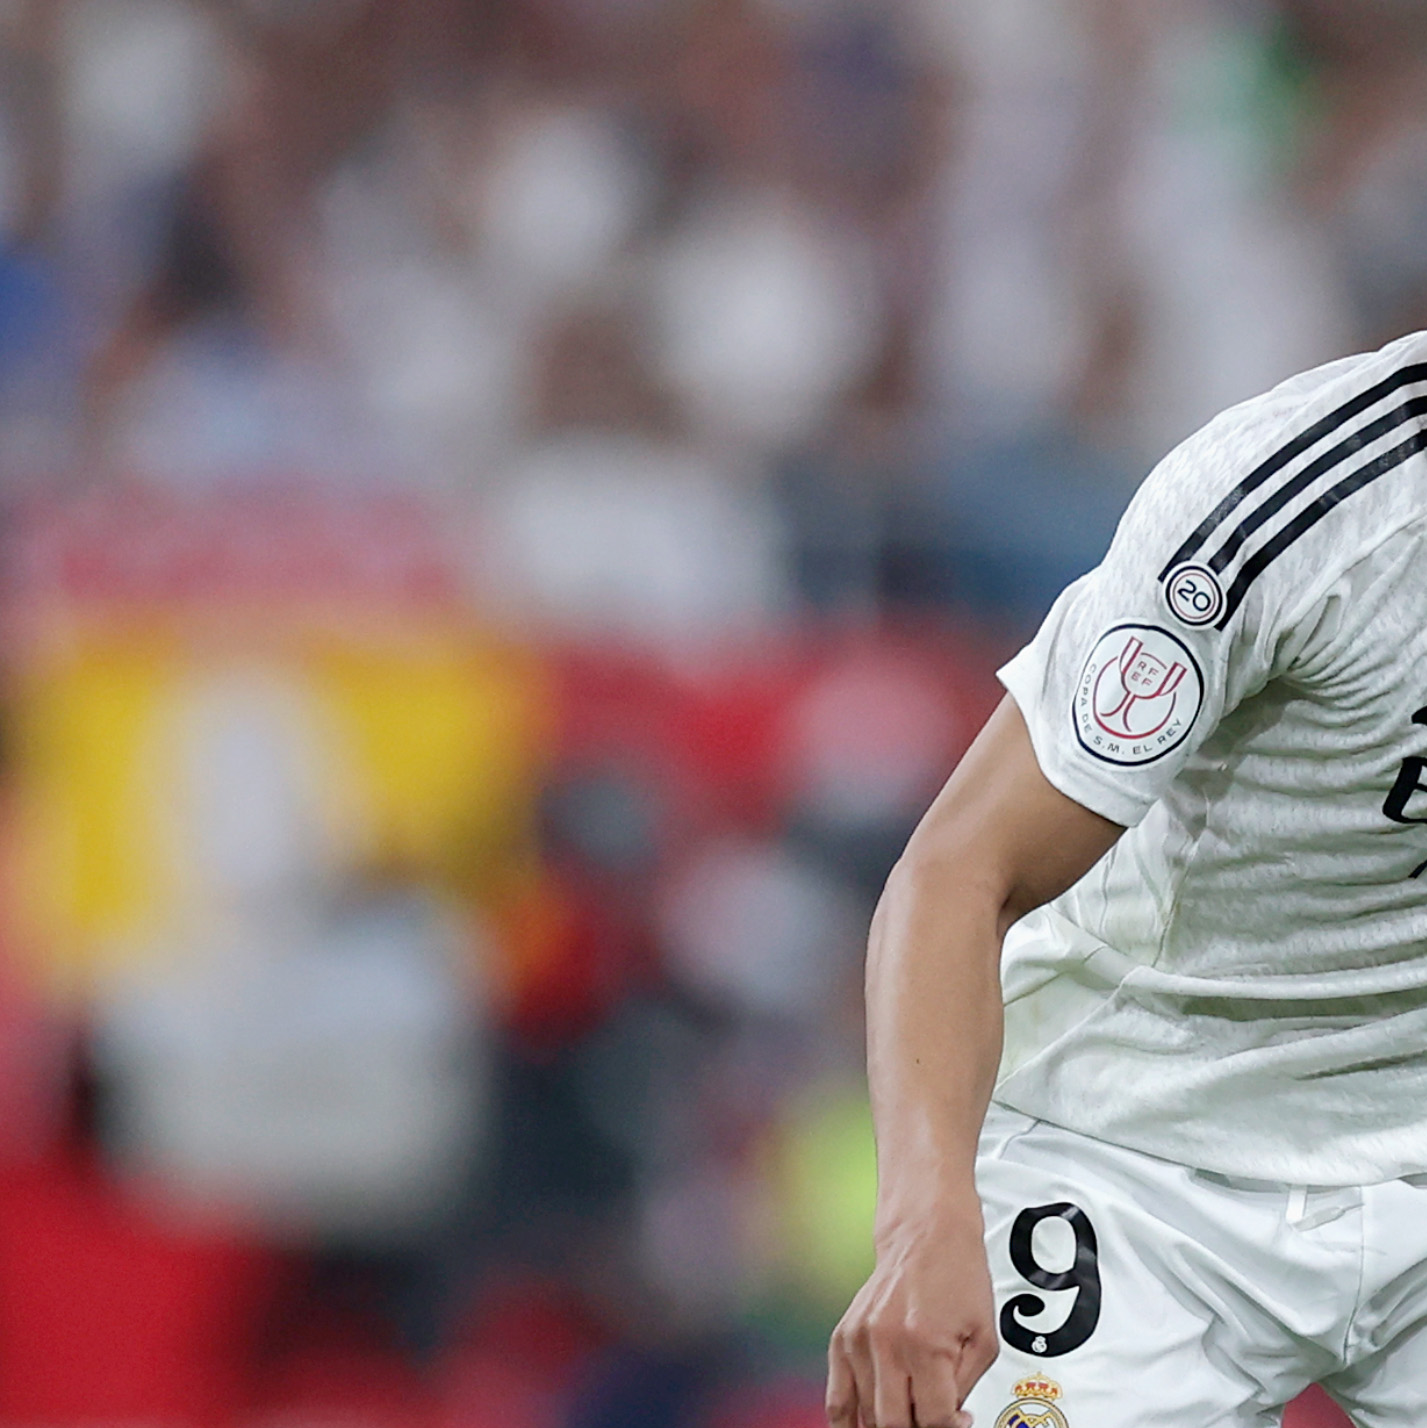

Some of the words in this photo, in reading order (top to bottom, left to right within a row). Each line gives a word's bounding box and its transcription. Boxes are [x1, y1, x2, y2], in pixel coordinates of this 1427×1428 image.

[1177, 579, 1211, 611] 20
[1080, 662, 1098, 707] COPA
[1081, 712, 1094, 733] DE
[1156, 717, 1183, 745] REY
[1132, 743, 1153, 756] EL
[1000, 1202, 1102, 1358] 9
